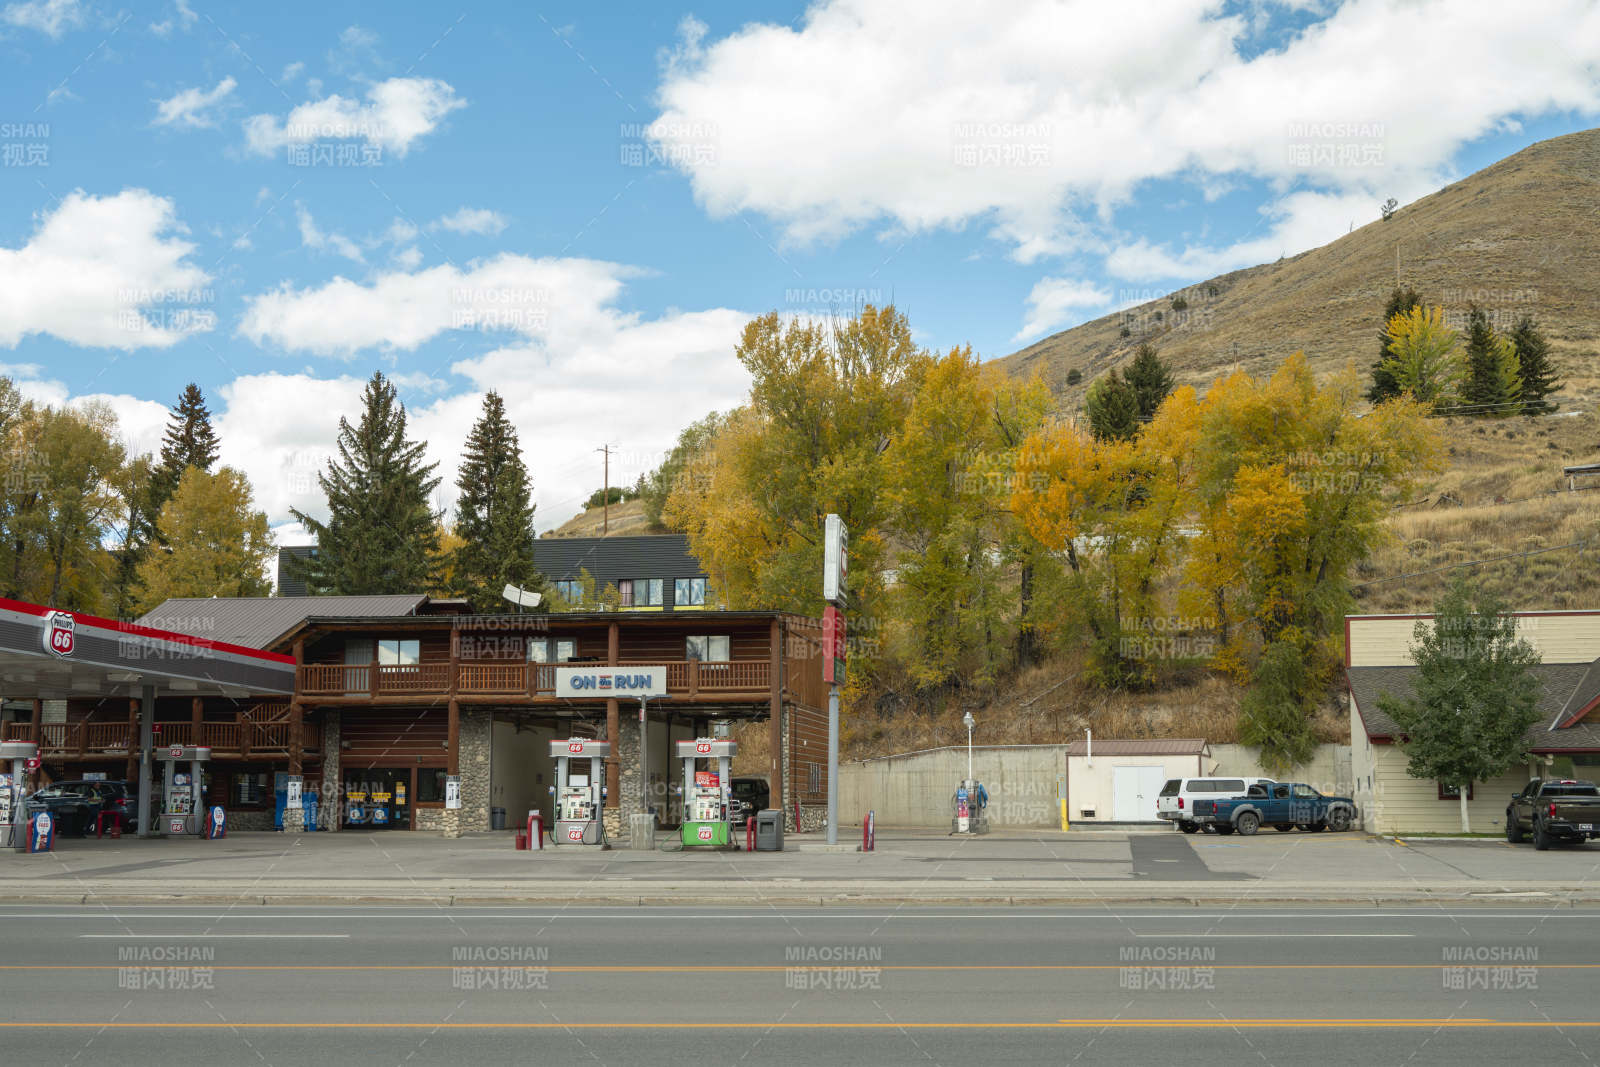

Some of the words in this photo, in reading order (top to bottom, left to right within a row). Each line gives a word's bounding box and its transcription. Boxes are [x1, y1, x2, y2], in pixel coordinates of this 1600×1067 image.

[54, 631, 71, 648] 66
[570, 675, 596, 689] ON
[614, 674, 652, 689] RUN
[570, 744, 581, 752] 66
[698, 744, 709, 752] 66
[570, 831, 581, 839] 66
[700, 831, 711, 839] 66
